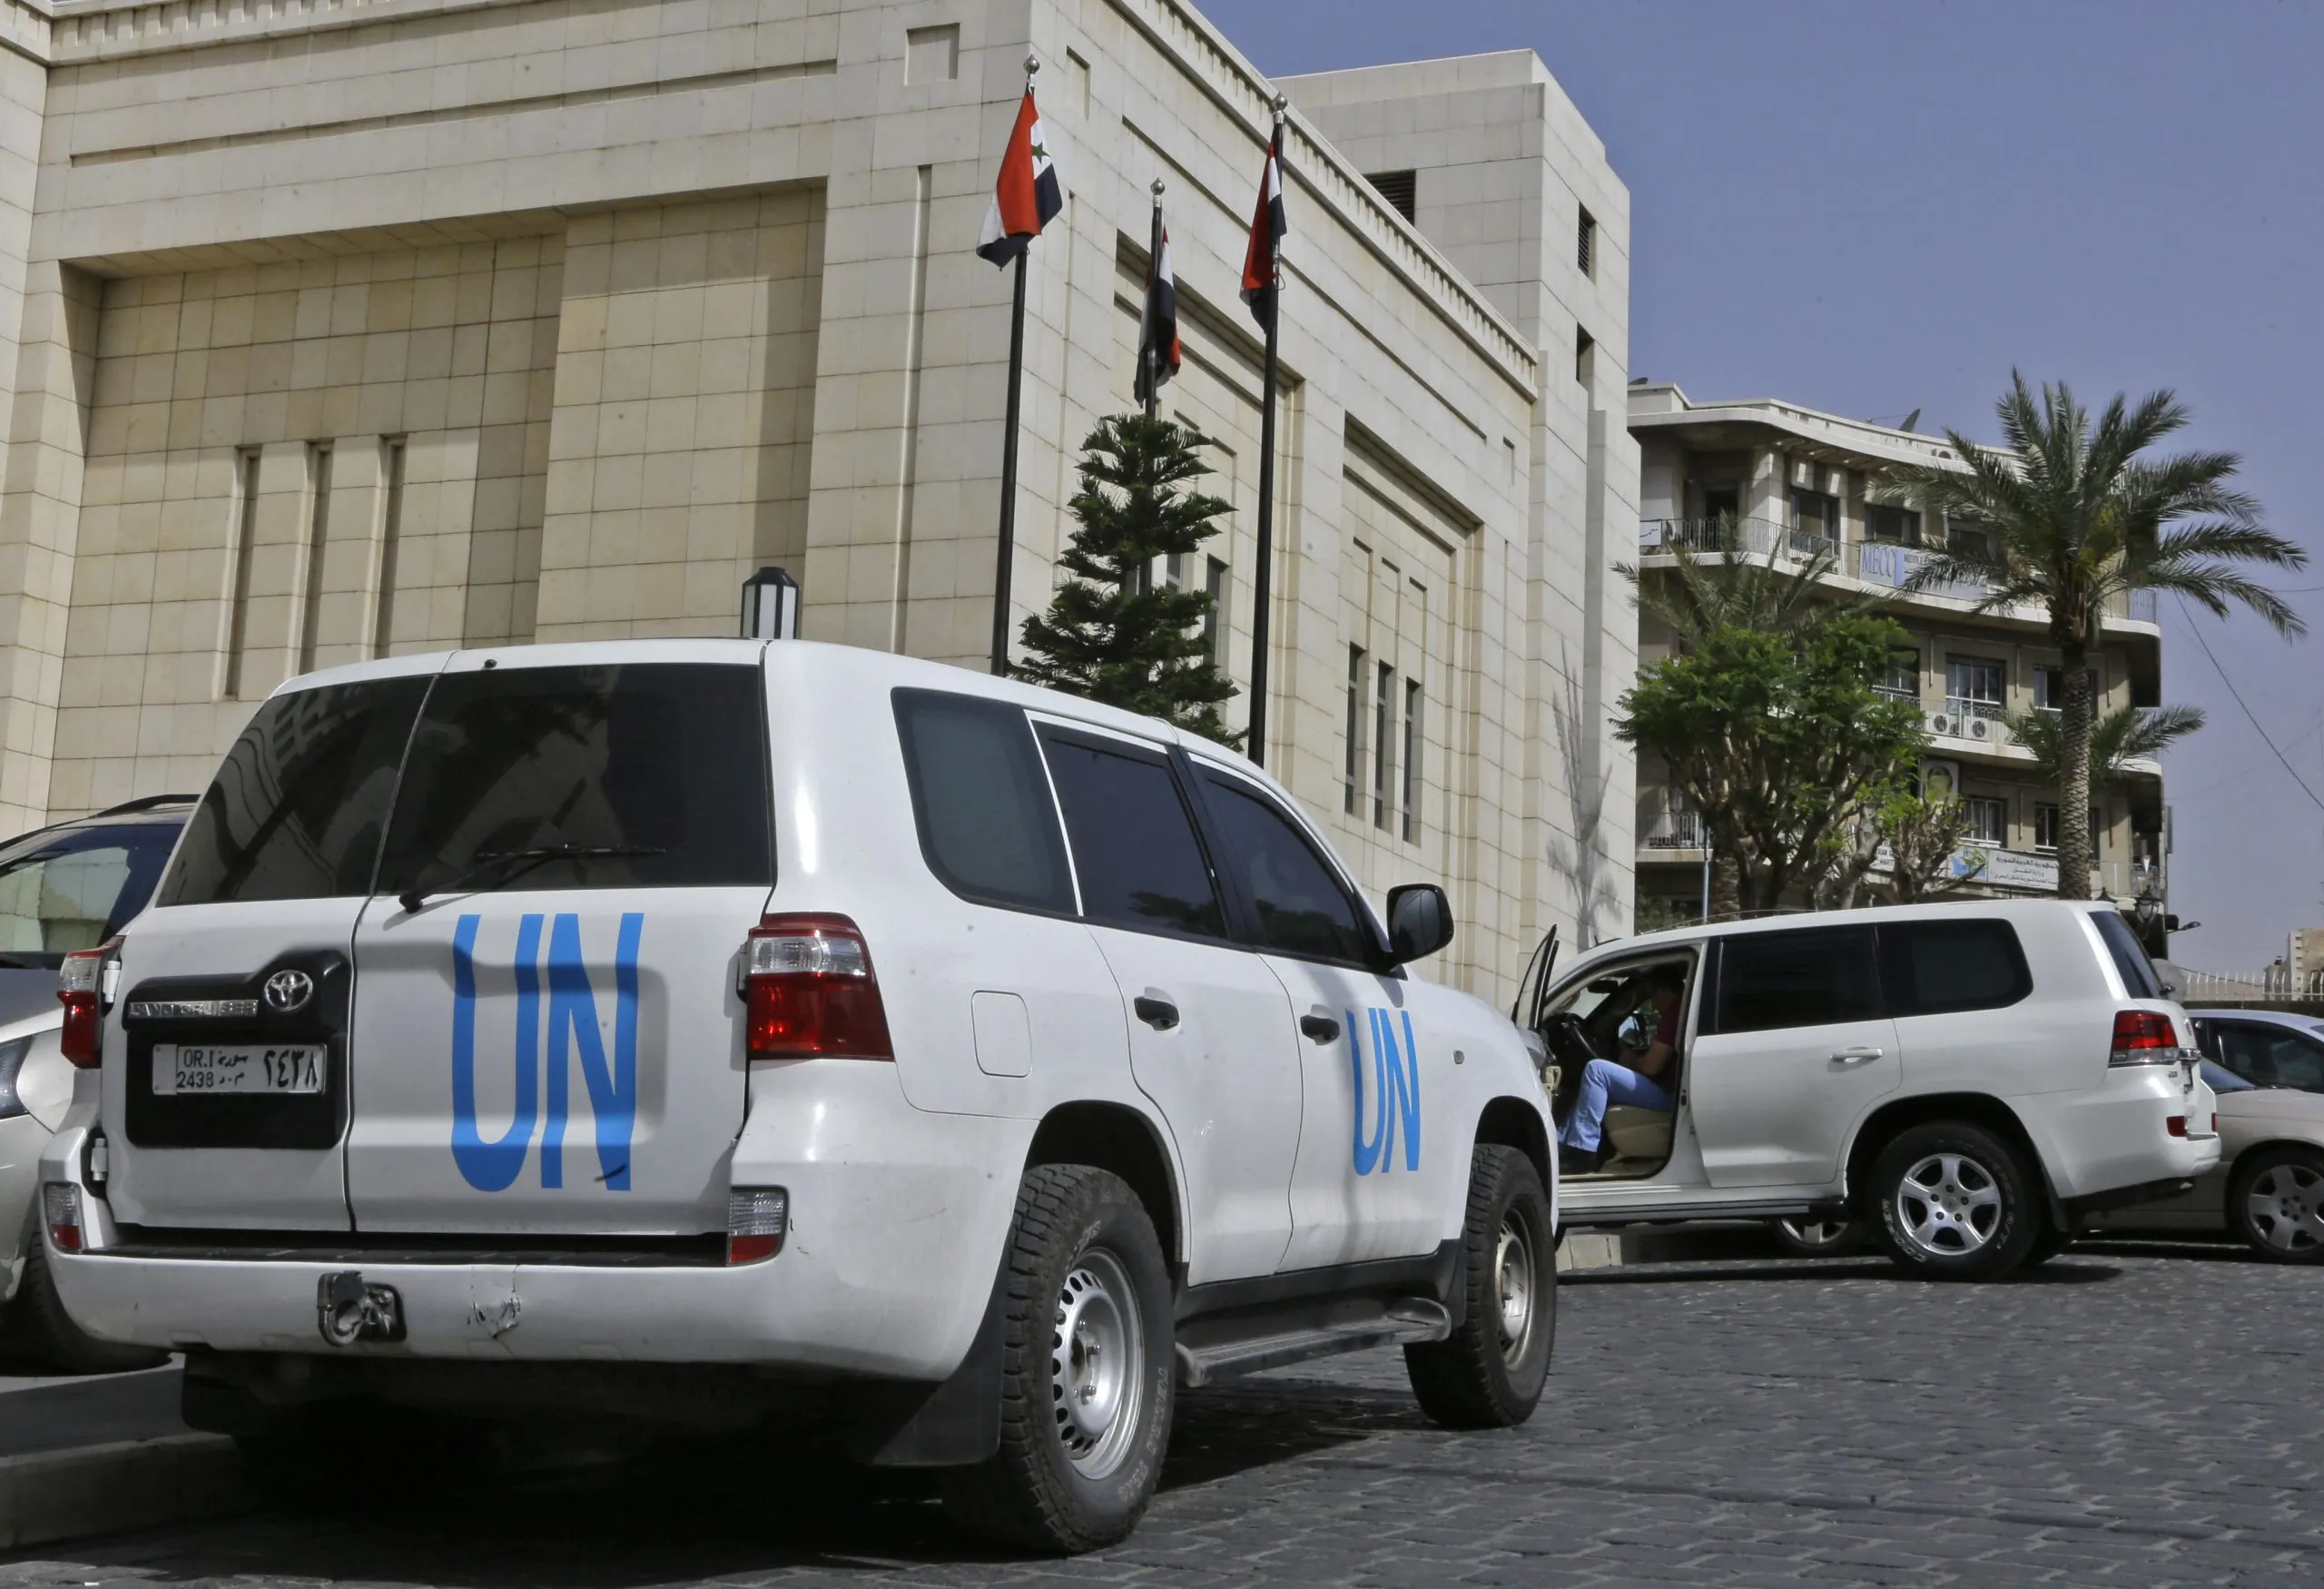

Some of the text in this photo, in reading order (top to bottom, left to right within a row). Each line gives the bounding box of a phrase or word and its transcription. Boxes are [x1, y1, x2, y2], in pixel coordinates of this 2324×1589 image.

[176, 1071, 214, 1089] 2438
[451, 913, 645, 1192] UN
[1345, 1007, 1421, 1176] UN
